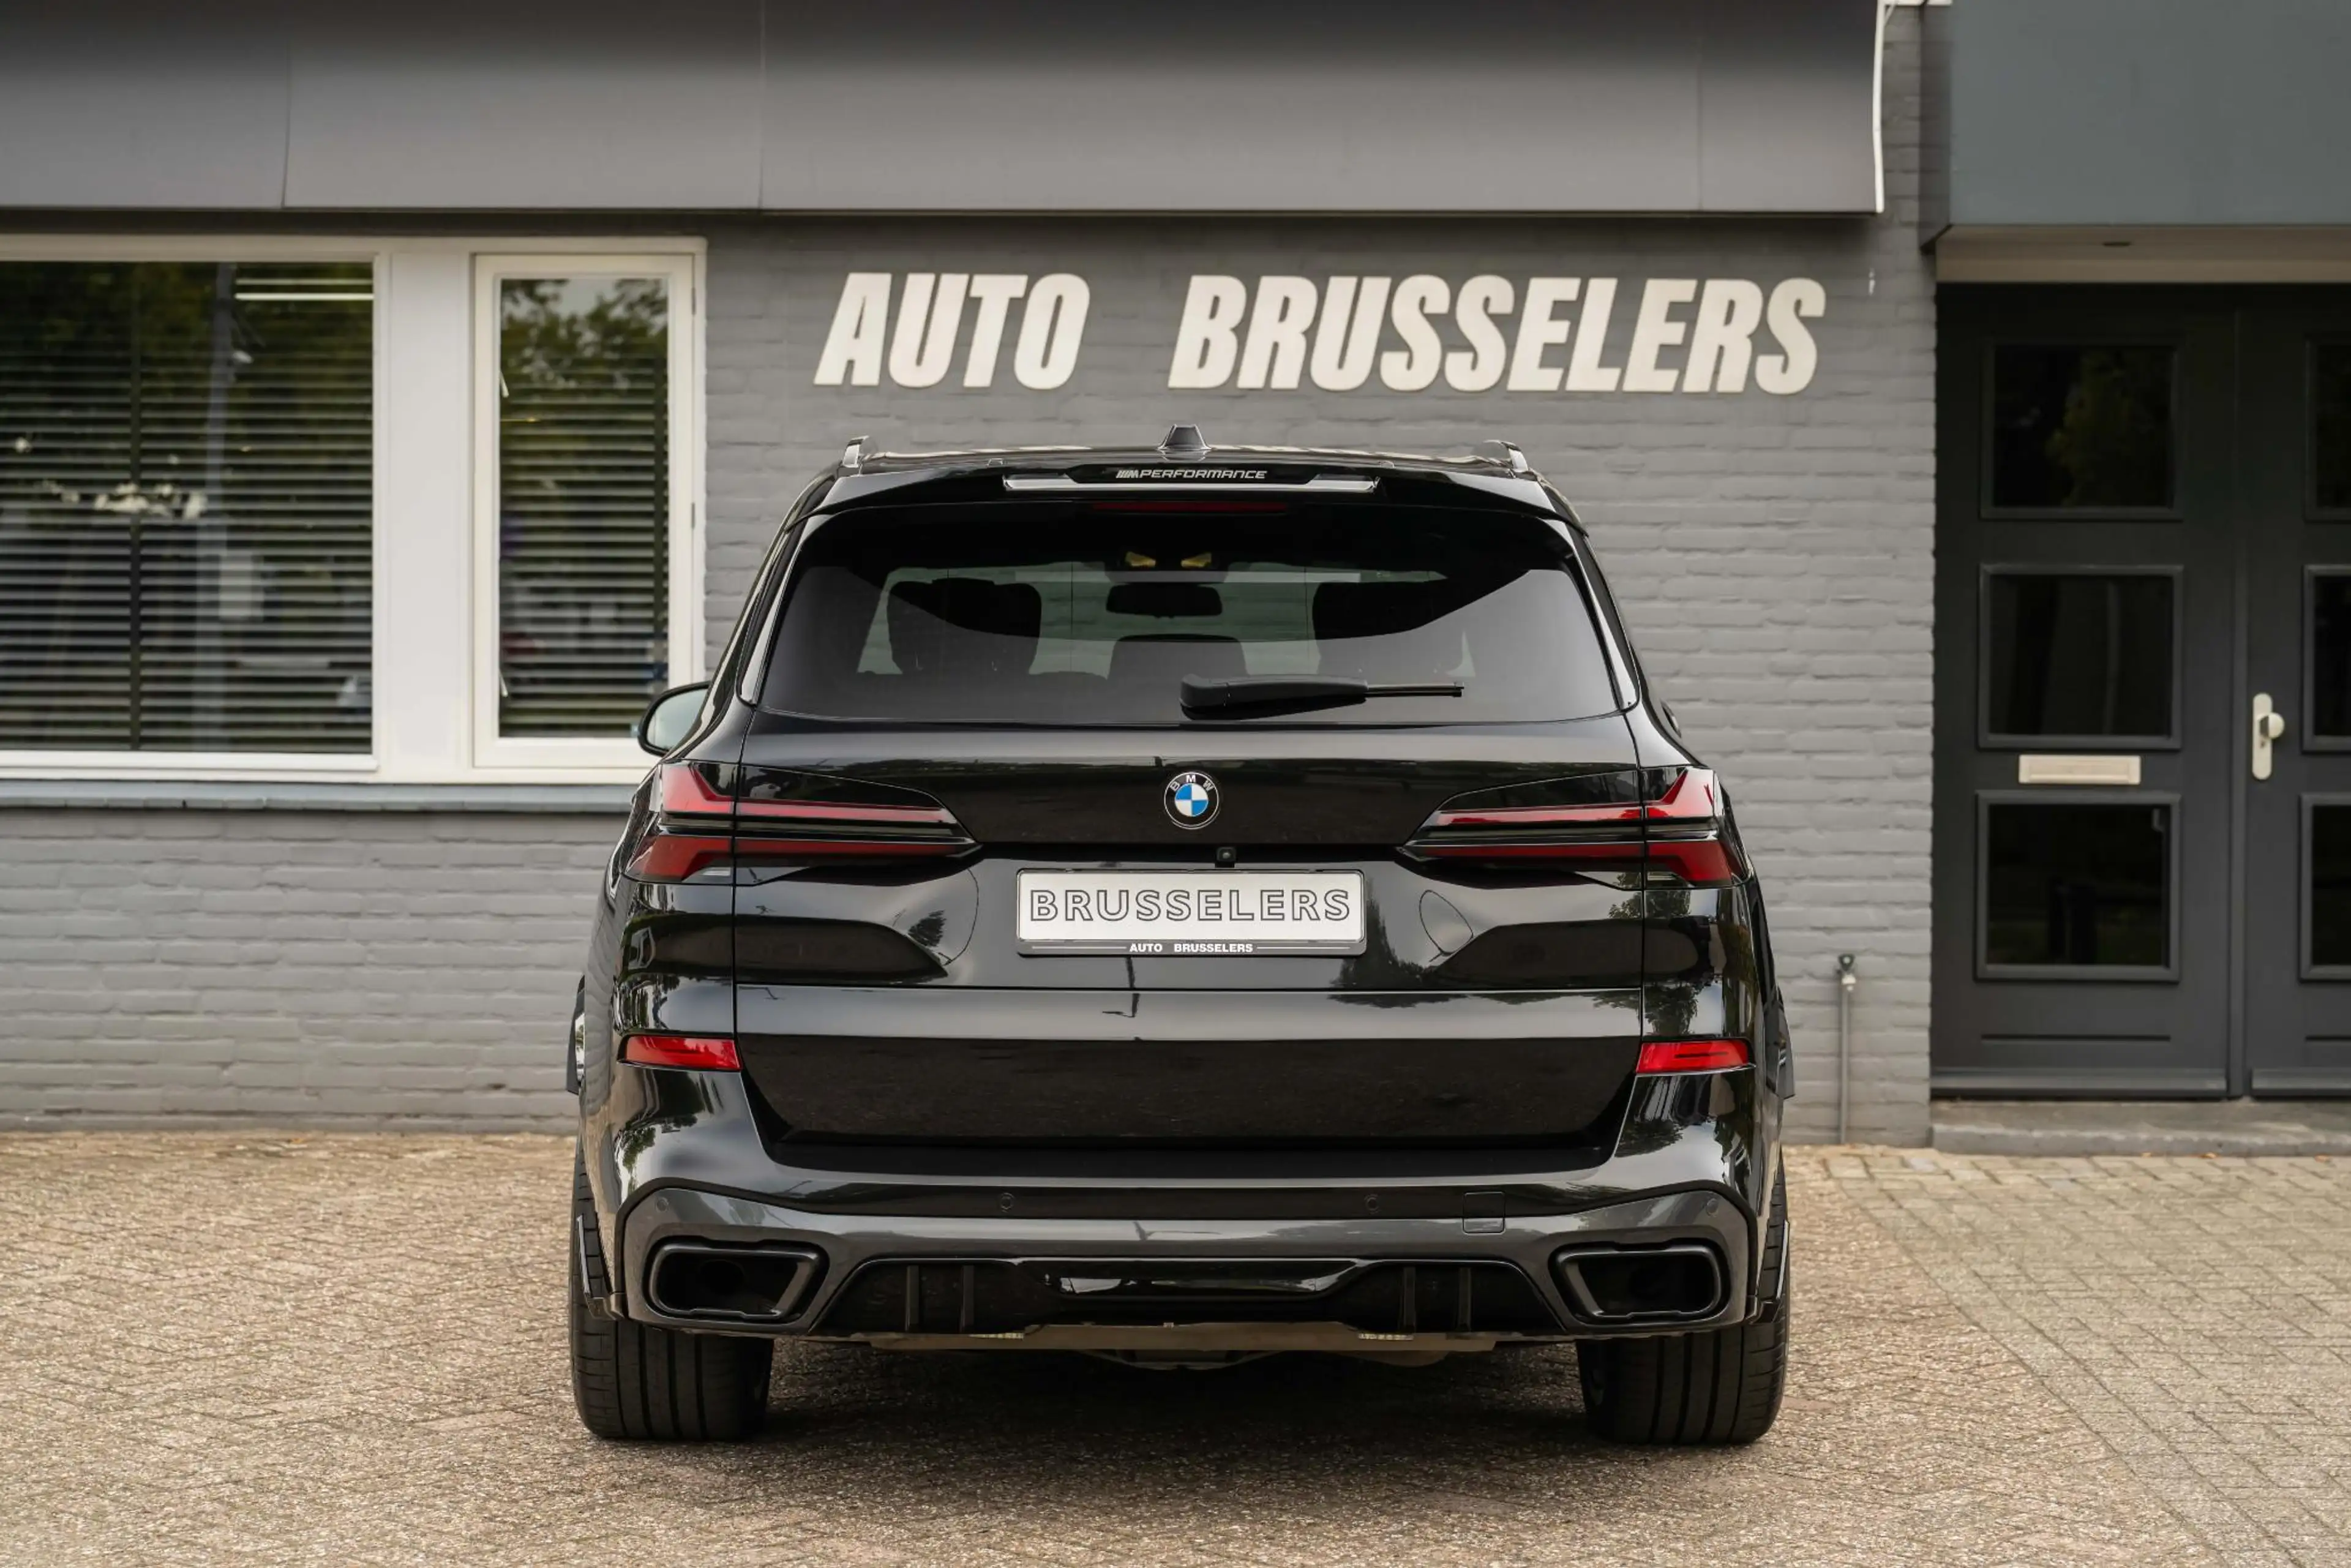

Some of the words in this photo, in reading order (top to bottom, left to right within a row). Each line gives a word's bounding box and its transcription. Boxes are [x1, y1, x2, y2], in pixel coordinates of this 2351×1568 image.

[814, 272, 1090, 389] AUTO
[1168, 274, 1826, 394] BRUSSELERS
[1170, 775, 1214, 792] BMW
[1030, 890, 1350, 921] BRUSSELERS
[1130, 943, 1163, 953] AUTO
[1174, 943, 1253, 953] BRUSSELERS
